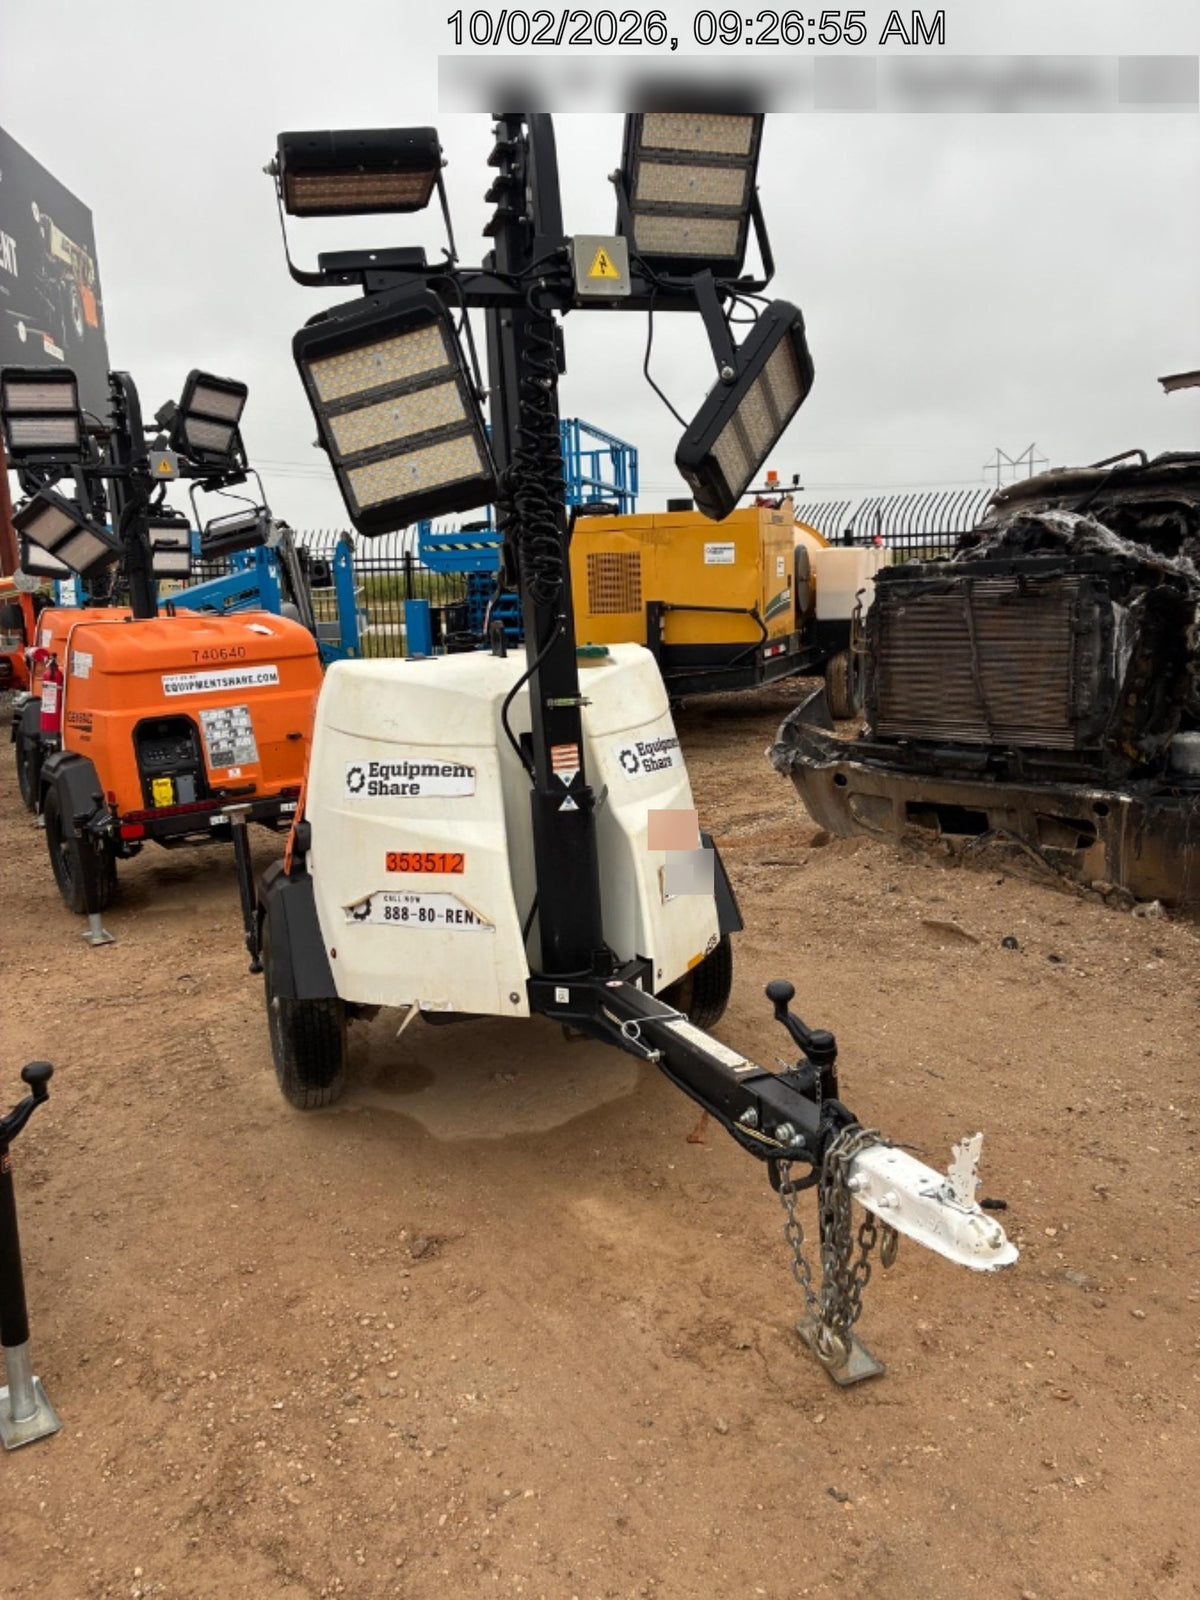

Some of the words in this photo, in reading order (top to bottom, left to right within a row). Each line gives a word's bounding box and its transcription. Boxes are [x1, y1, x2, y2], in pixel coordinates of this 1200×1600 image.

[191, 646, 247, 662] 740640
[368, 761, 475, 780] Equipment
[367, 780, 421, 796] Share
[386, 852, 465, 874] 353512
